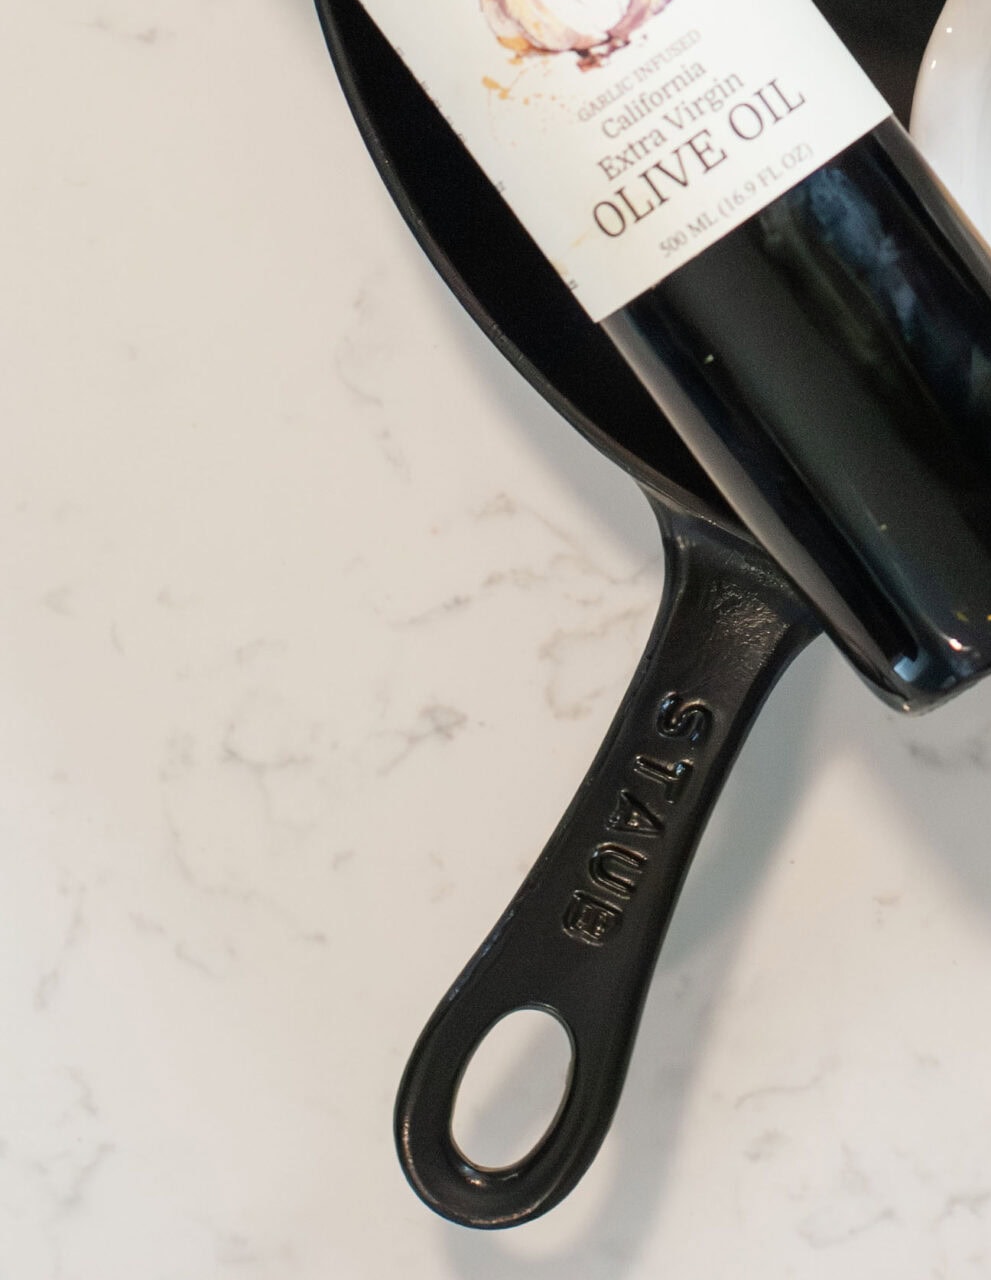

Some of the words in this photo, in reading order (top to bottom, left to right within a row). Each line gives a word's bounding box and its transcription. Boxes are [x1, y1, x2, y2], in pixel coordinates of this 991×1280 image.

[577, 76, 634, 122] GARLIC
[633, 28, 702, 86] INFUSED
[597, 128, 668, 182] Extra
[663, 73, 745, 132] Virgin
[602, 61, 707, 139] California
[592, 129, 728, 238] OLIVE
[728, 78, 806, 141] OIL
[659, 230, 688, 258] 500
[686, 212, 719, 238] ML
[717, 181, 757, 218] (16.9
[756, 166, 783, 188] FL
[781, 143, 814, 170] OZ)
[561, 690, 716, 947] STAUB
